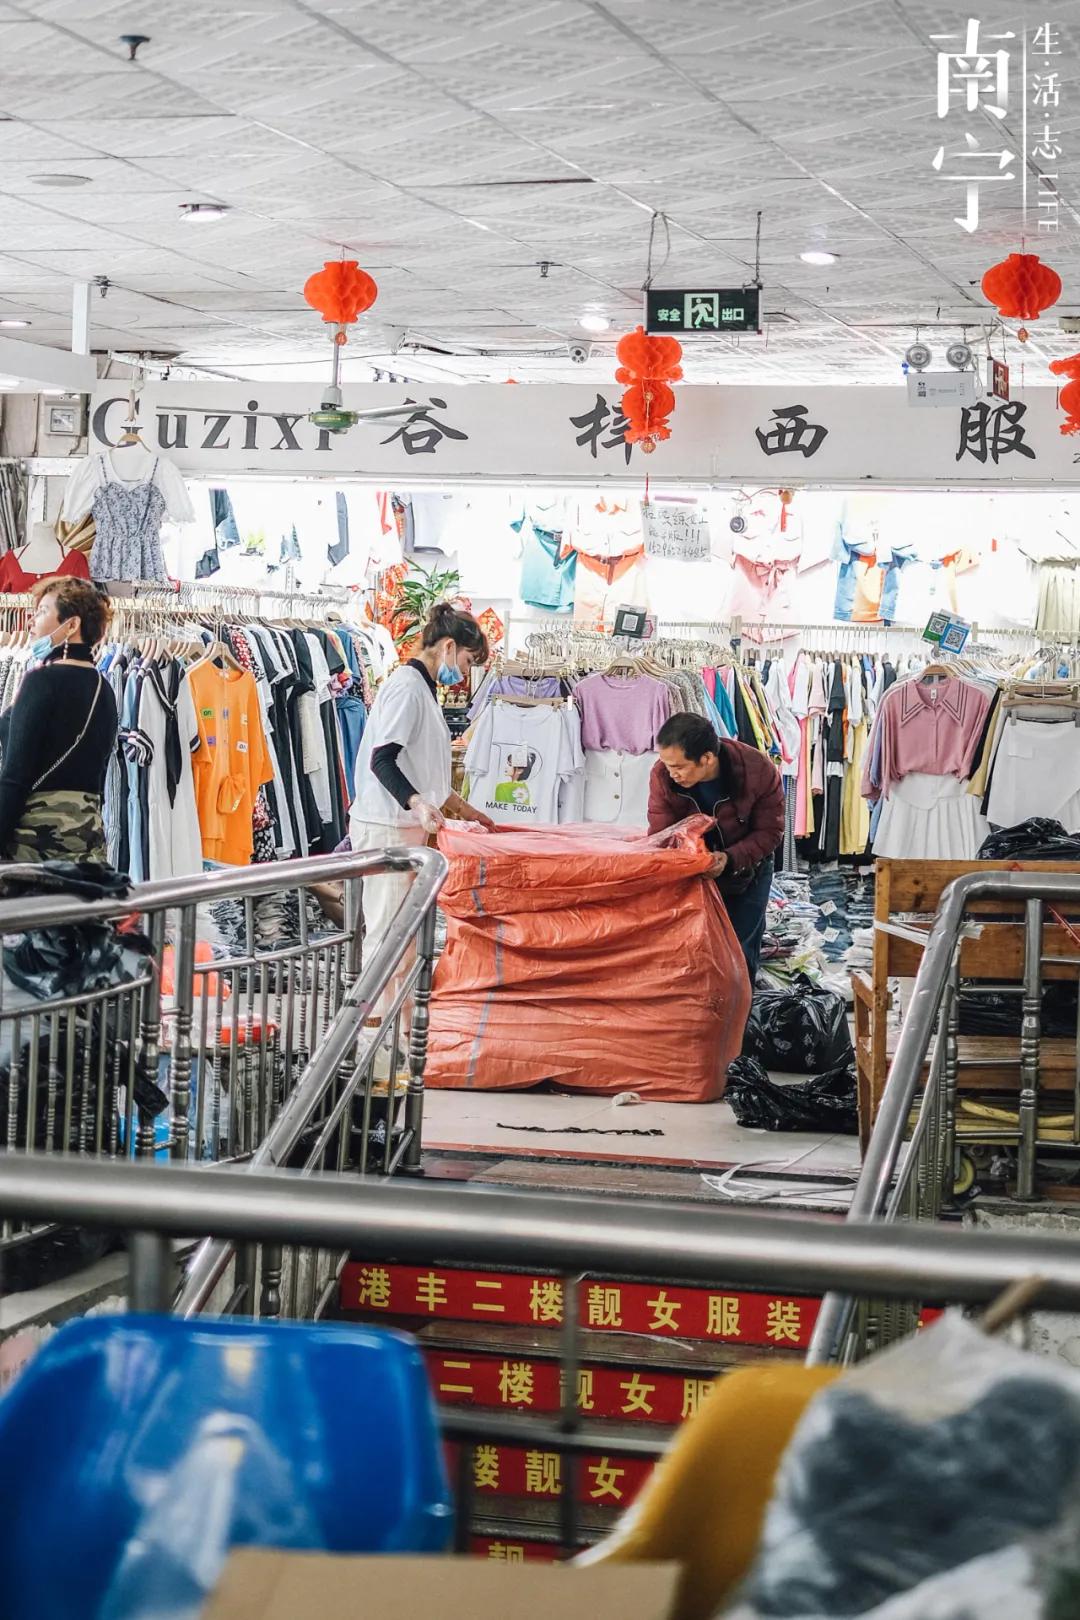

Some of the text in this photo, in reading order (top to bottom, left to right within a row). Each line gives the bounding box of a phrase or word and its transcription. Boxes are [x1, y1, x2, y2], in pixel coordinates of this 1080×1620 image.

[657, 307, 744, 322] 安全 出口
[485, 801, 538, 814] MAKE TODAY
[359, 1267, 802, 1343] 港丰二楼靓女服装
